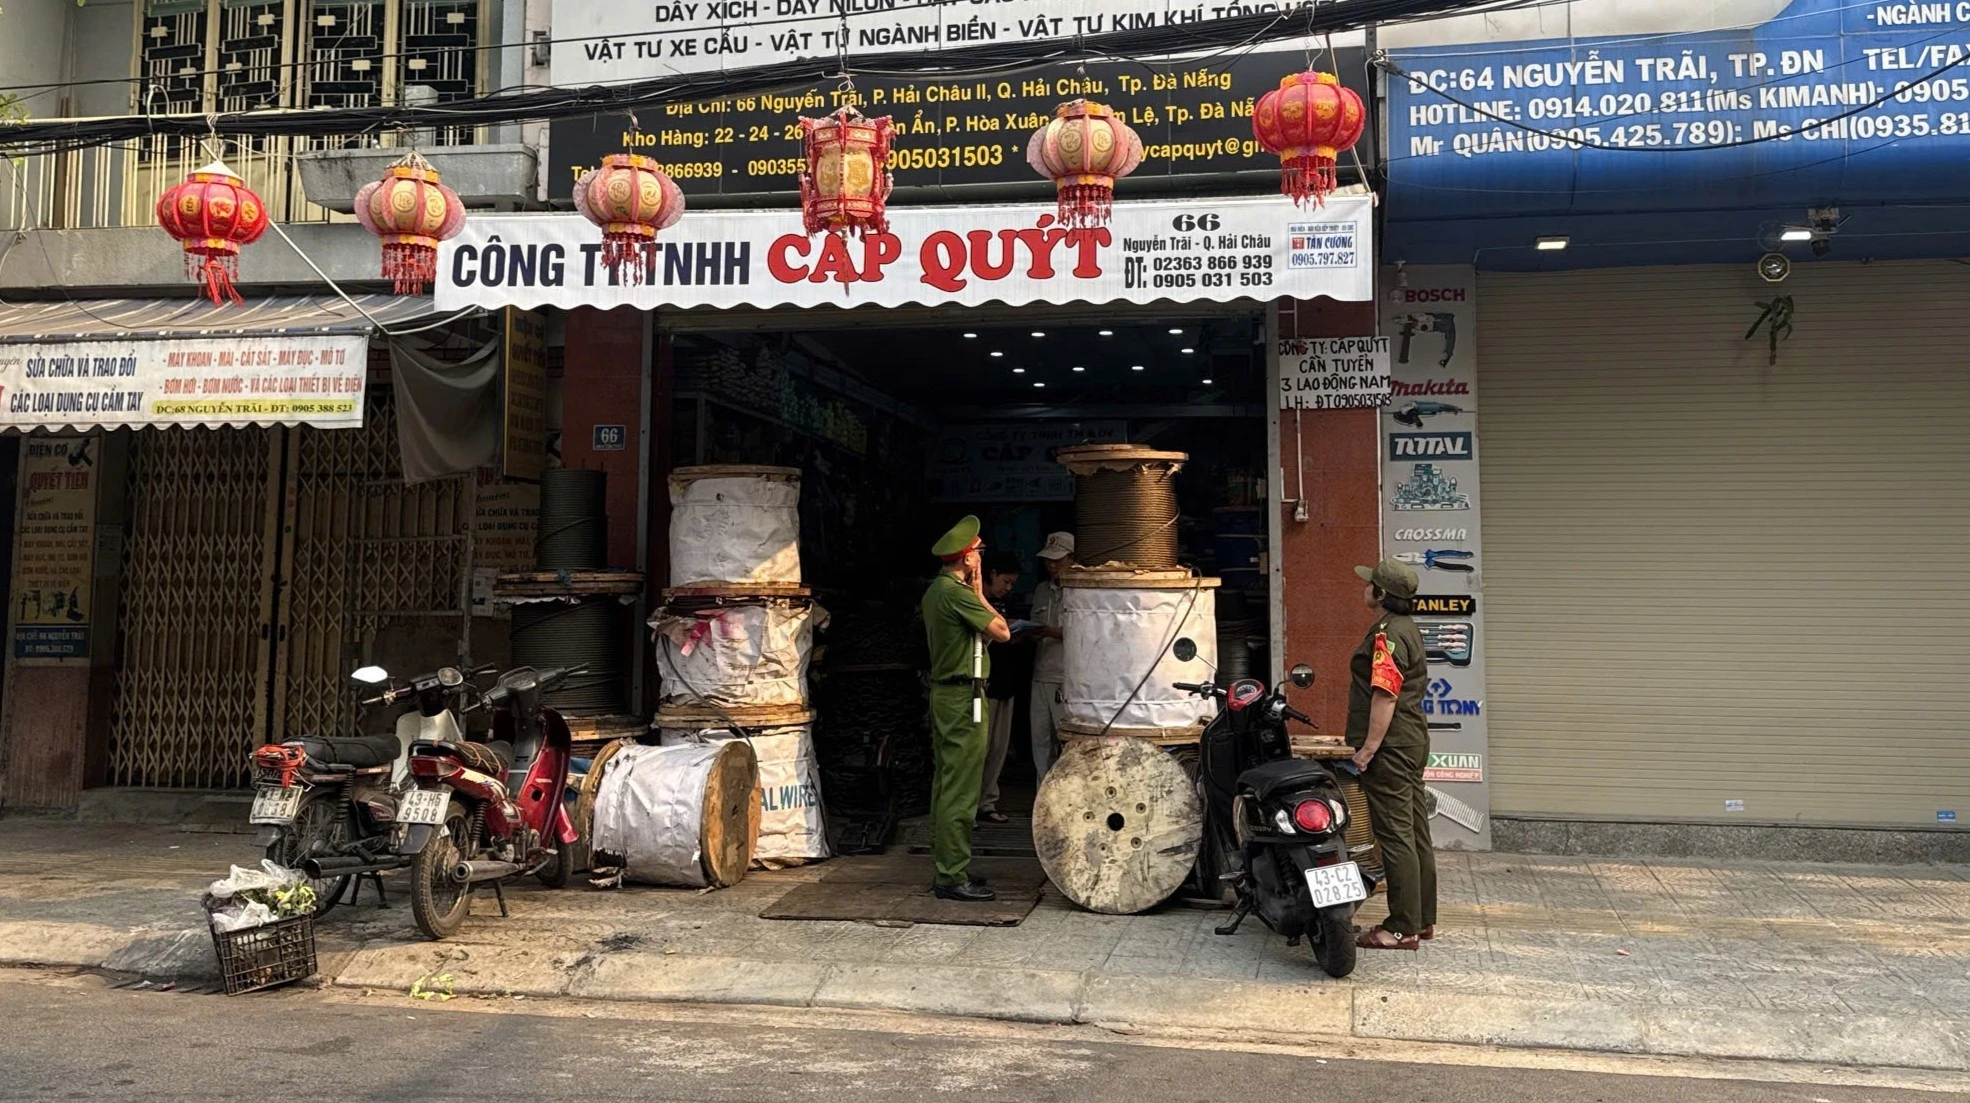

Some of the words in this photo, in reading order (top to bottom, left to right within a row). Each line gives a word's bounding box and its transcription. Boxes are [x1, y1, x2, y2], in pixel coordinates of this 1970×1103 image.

[655, 0, 699, 22] DÂY
[584, 41, 626, 64] VẬT
[633, 40, 664, 60] TƯ
[669, 38, 697, 58] XE
[703, 25, 749, 56] CẨU
[770, 28, 813, 57] VẬT
[859, 22, 939, 47] NGÀNH
[946, 14, 997, 42] BIỂN
[1018, 13, 1063, 40] VẬT
[1073, 12, 1104, 34] TƯ
[1112, 13, 1156, 33] KIM
[1163, 4, 1204, 28] KHÍ
[1409, 66, 1494, 95] ĐC:64
[1503, 50, 1625, 89] NGUYỄN
[1634, 50, 1719, 85] TRÃI,
[736, 98, 757, 113] 66
[760, 89, 825, 114] Nguyễn
[872, 88, 887, 106] P.
[892, 84, 921, 104] Hải
[926, 78, 971, 104] Châu
[996, 82, 1016, 102] Q.
[1022, 75, 1051, 98] Hải
[1119, 75, 1148, 97] Tp.
[1153, 73, 1178, 91] Đà
[1183, 69, 1233, 93] Nẵng
[1409, 100, 1522, 127] HOTLINE:
[1894, 78, 1970, 105] 0905
[945, 115, 962, 133] P.
[966, 113, 998, 133] Hòa
[1131, 106, 1161, 129] Lệ,
[1166, 105, 1195, 127] Tp.
[1200, 101, 1225, 120] Đà
[622, 131, 656, 148] Kho
[661, 128, 710, 149] Hàng:
[714, 128, 735, 144] 22
[748, 126, 770, 141] 24
[783, 124, 804, 141] 26
[1409, 136, 1445, 158] Mr
[1752, 119, 1793, 142] Ms
[1172, 213, 1222, 233] 66
[451, 234, 566, 288] CÔNG
[919, 213, 1113, 293] QUÝT
[1122, 235, 1167, 254] Nguyễn
[1169, 235, 1192, 251] Trãi
[1203, 235, 1215, 251] Q.
[1218, 233, 1238, 250] Hải
[1241, 233, 1271, 249] Châu
[1291, 251, 1355, 267] 0905.797.827
[1124, 257, 1147, 289] ĐT:
[1153, 256, 1203, 272] 02363
[1207, 255, 1238, 270] 866
[1242, 254, 1273, 270] 939
[1153, 273, 1197, 288] 0905
[1201, 273, 1232, 287] 031
[1240, 271, 1273, 287] 503
[1405, 287, 1466, 303] BOSCH
[48, 353, 75, 378] CHỮA
[78, 352, 90, 378] VÀ
[92, 356, 118, 377] TRAO
[118, 348, 138, 377] ĐỔI
[186, 351, 213, 367] KHOAN
[1299, 355, 1327, 374] CẦN
[1331, 354, 1375, 373] TUYỂN
[262, 374, 278, 394] CÁC
[1281, 377, 1293, 392] 3
[1297, 377, 1321, 392] LAO
[1322, 373, 1358, 393] ĐỘNG
[1360, 375, 1392, 390] NAM
[1390, 377, 1470, 397] Makita
[10, 388, 31, 413] CÁC
[32, 391, 55, 417] LOẠI
[56, 391, 84, 417] DỤNG
[85, 390, 100, 417] CỤ
[126, 390, 144, 412] TAY
[187, 401, 233, 414] NGUYỄN
[291, 403, 315, 413] 0905
[316, 403, 334, 413] 388
[336, 403, 353, 413] 523
[1286, 395, 1310, 410] LH:
[600, 427, 619, 444] 66
[1393, 436, 1469, 456] TOTAL
[402, 806, 438, 822] 9508
